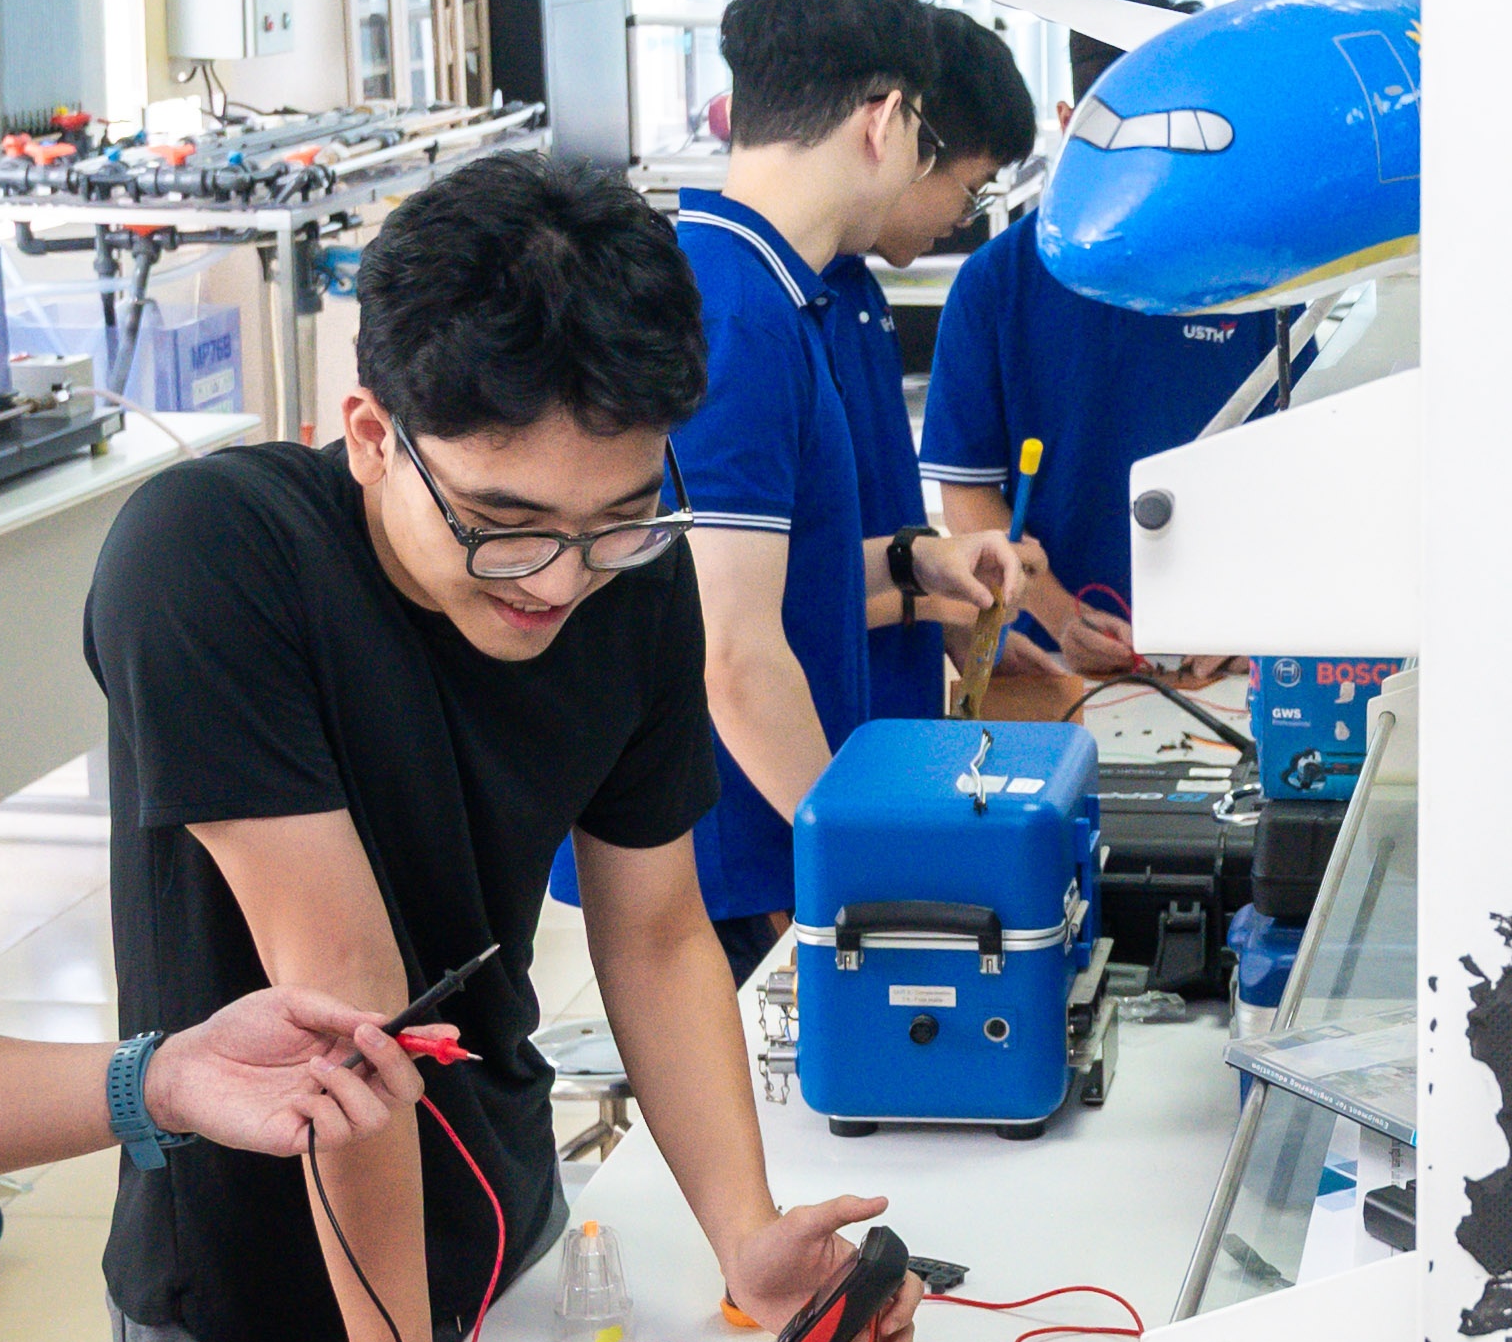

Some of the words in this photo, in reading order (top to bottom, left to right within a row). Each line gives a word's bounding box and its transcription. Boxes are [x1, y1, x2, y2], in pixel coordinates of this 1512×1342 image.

[1182, 323, 1224, 344] USTH
[1316, 662, 1399, 686] BOSC
[1271, 707, 1302, 720] GWS
